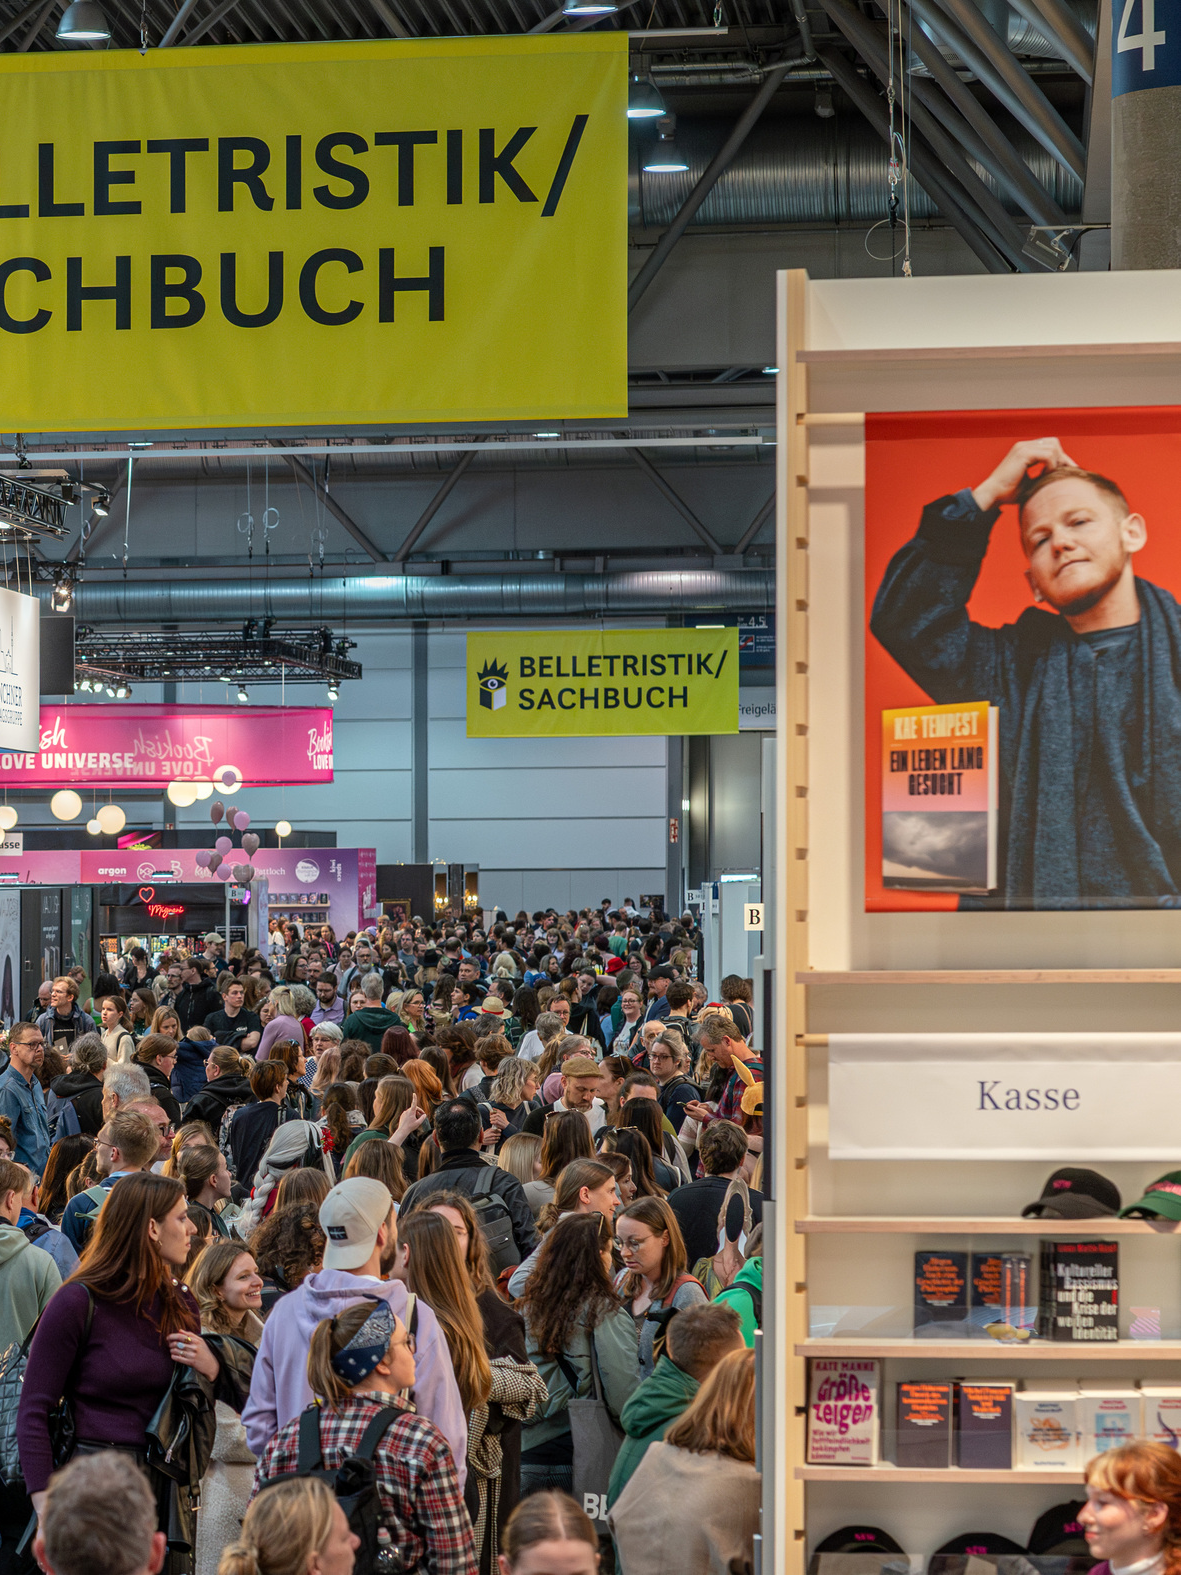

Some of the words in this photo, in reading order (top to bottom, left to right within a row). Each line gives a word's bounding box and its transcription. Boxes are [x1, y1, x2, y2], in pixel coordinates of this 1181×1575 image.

[519, 650, 728, 679] BELLETRISTIK/
[519, 686, 688, 710] SACHBUCH
[894, 716, 918, 740] KAE
[921, 711, 979, 738] TEMPEST
[41, 752, 135, 769] UNIVERSE
[890, 750, 908, 772] EIN
[911, 748, 947, 771] LEBEN
[951, 746, 983, 770] LANG
[908, 772, 963, 796] GESUCHT
[98, 867, 127, 877] argon
[749, 909, 761, 925] B
[976, 1080, 1081, 1111] Kasse
[1057, 1290, 1076, 1303] und
[1072, 1301, 1099, 1316] Krise
[1099, 1301, 1117, 1316] der
[816, 1361, 838, 1372] KATE
[841, 1361, 875, 1372] MANNE
[817, 1373, 871, 1402] Größe
[813, 1403, 873, 1436] zeigen
